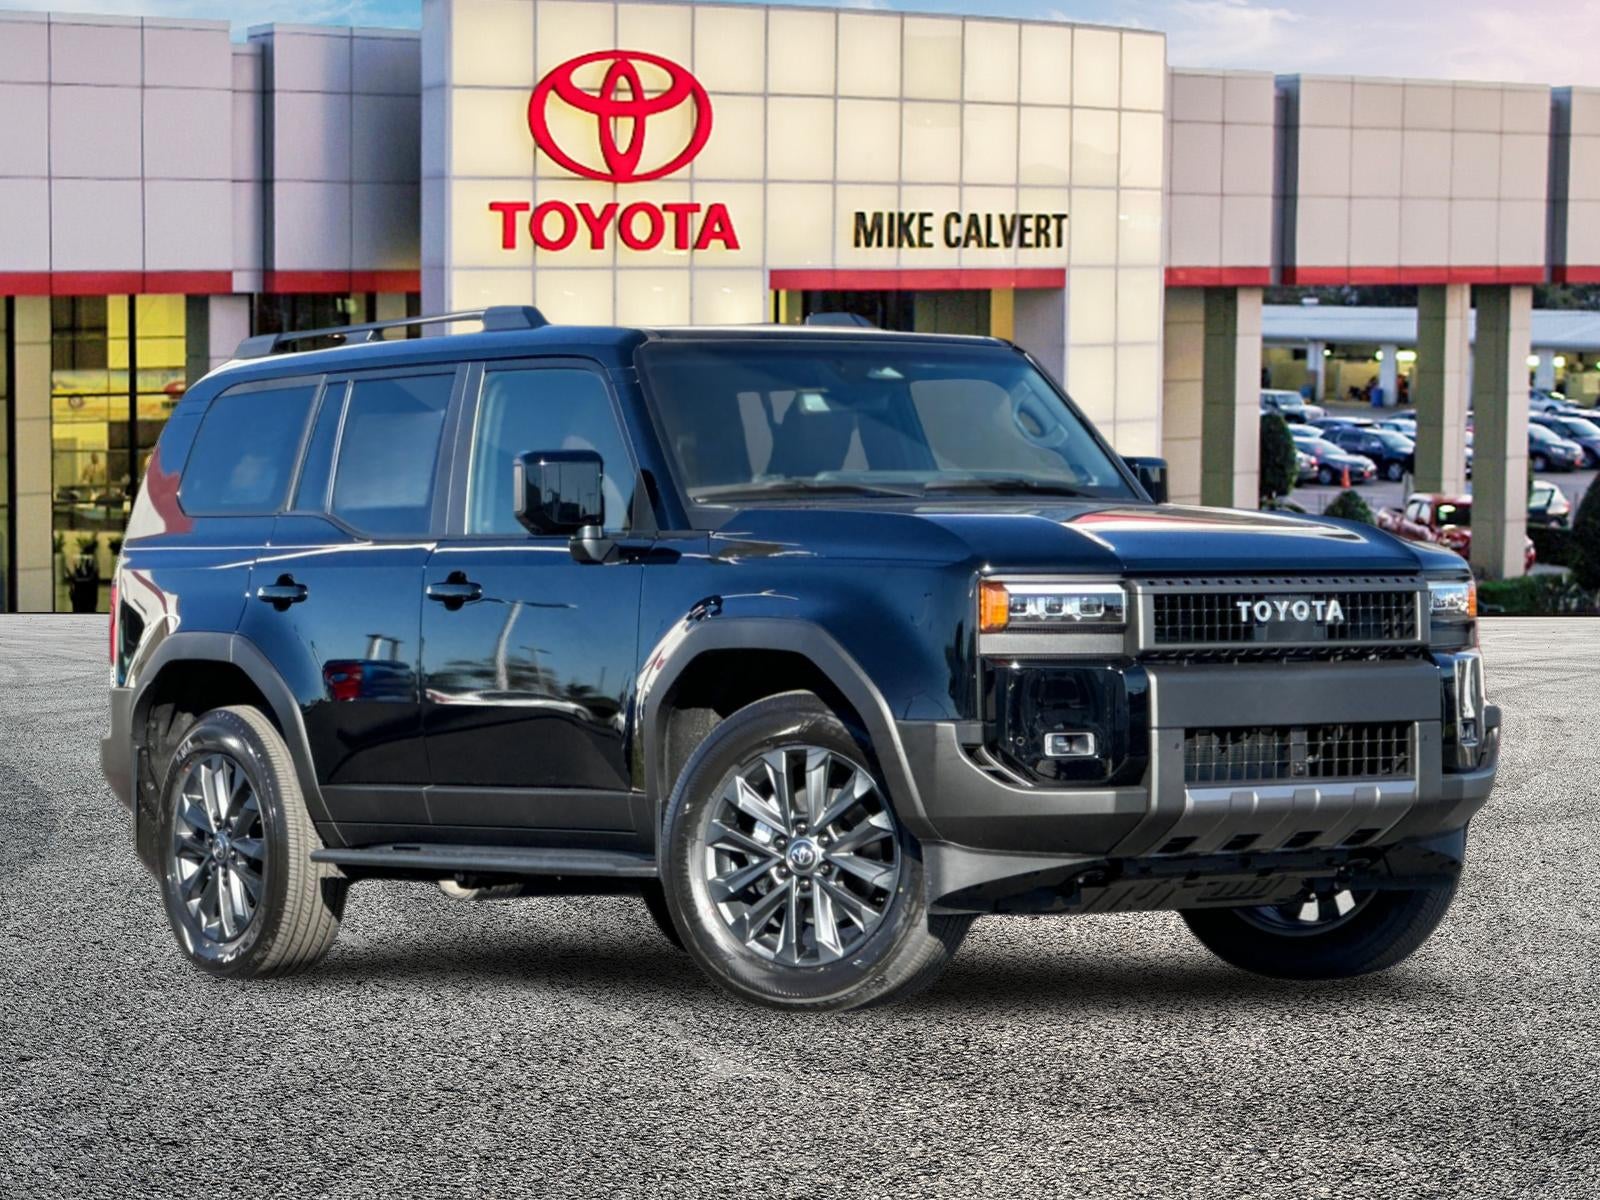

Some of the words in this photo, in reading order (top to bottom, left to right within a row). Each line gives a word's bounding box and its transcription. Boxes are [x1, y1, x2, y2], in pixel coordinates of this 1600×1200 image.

[489, 200, 740, 252] TOYOTA
[853, 211, 934, 249] MIKE
[943, 211, 1069, 249] CALVERT
[1236, 599, 1344, 622] TOYOTA
